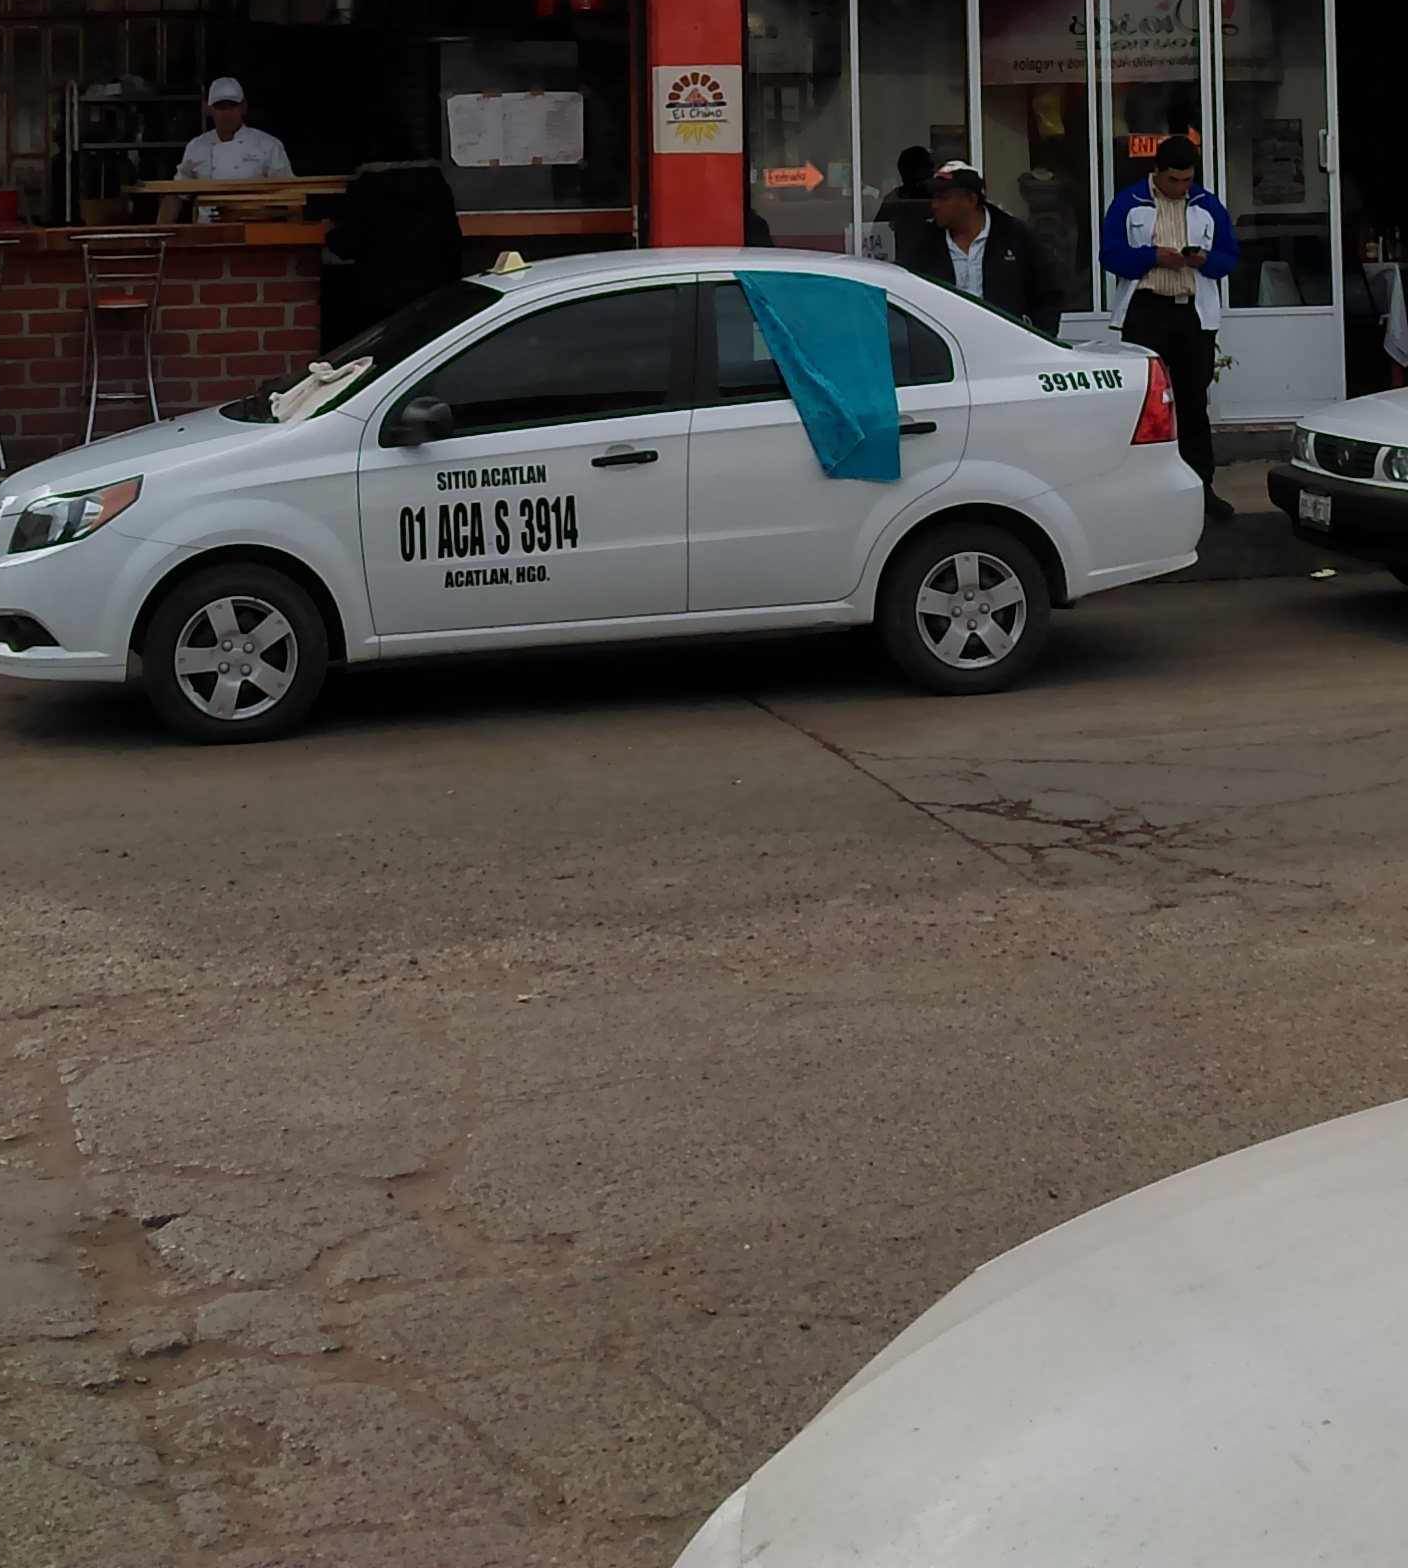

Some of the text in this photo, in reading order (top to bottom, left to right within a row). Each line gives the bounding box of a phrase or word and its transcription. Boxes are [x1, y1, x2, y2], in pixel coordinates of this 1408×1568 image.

[671, 109, 685, 120] El
[1038, 369, 1123, 393] 3914 FUF
[436, 464, 547, 491] SITIO ACATLAN
[399, 495, 579, 562] 01 ACA S 3914
[444, 564, 551, 589] ACATLAN, HGO.
